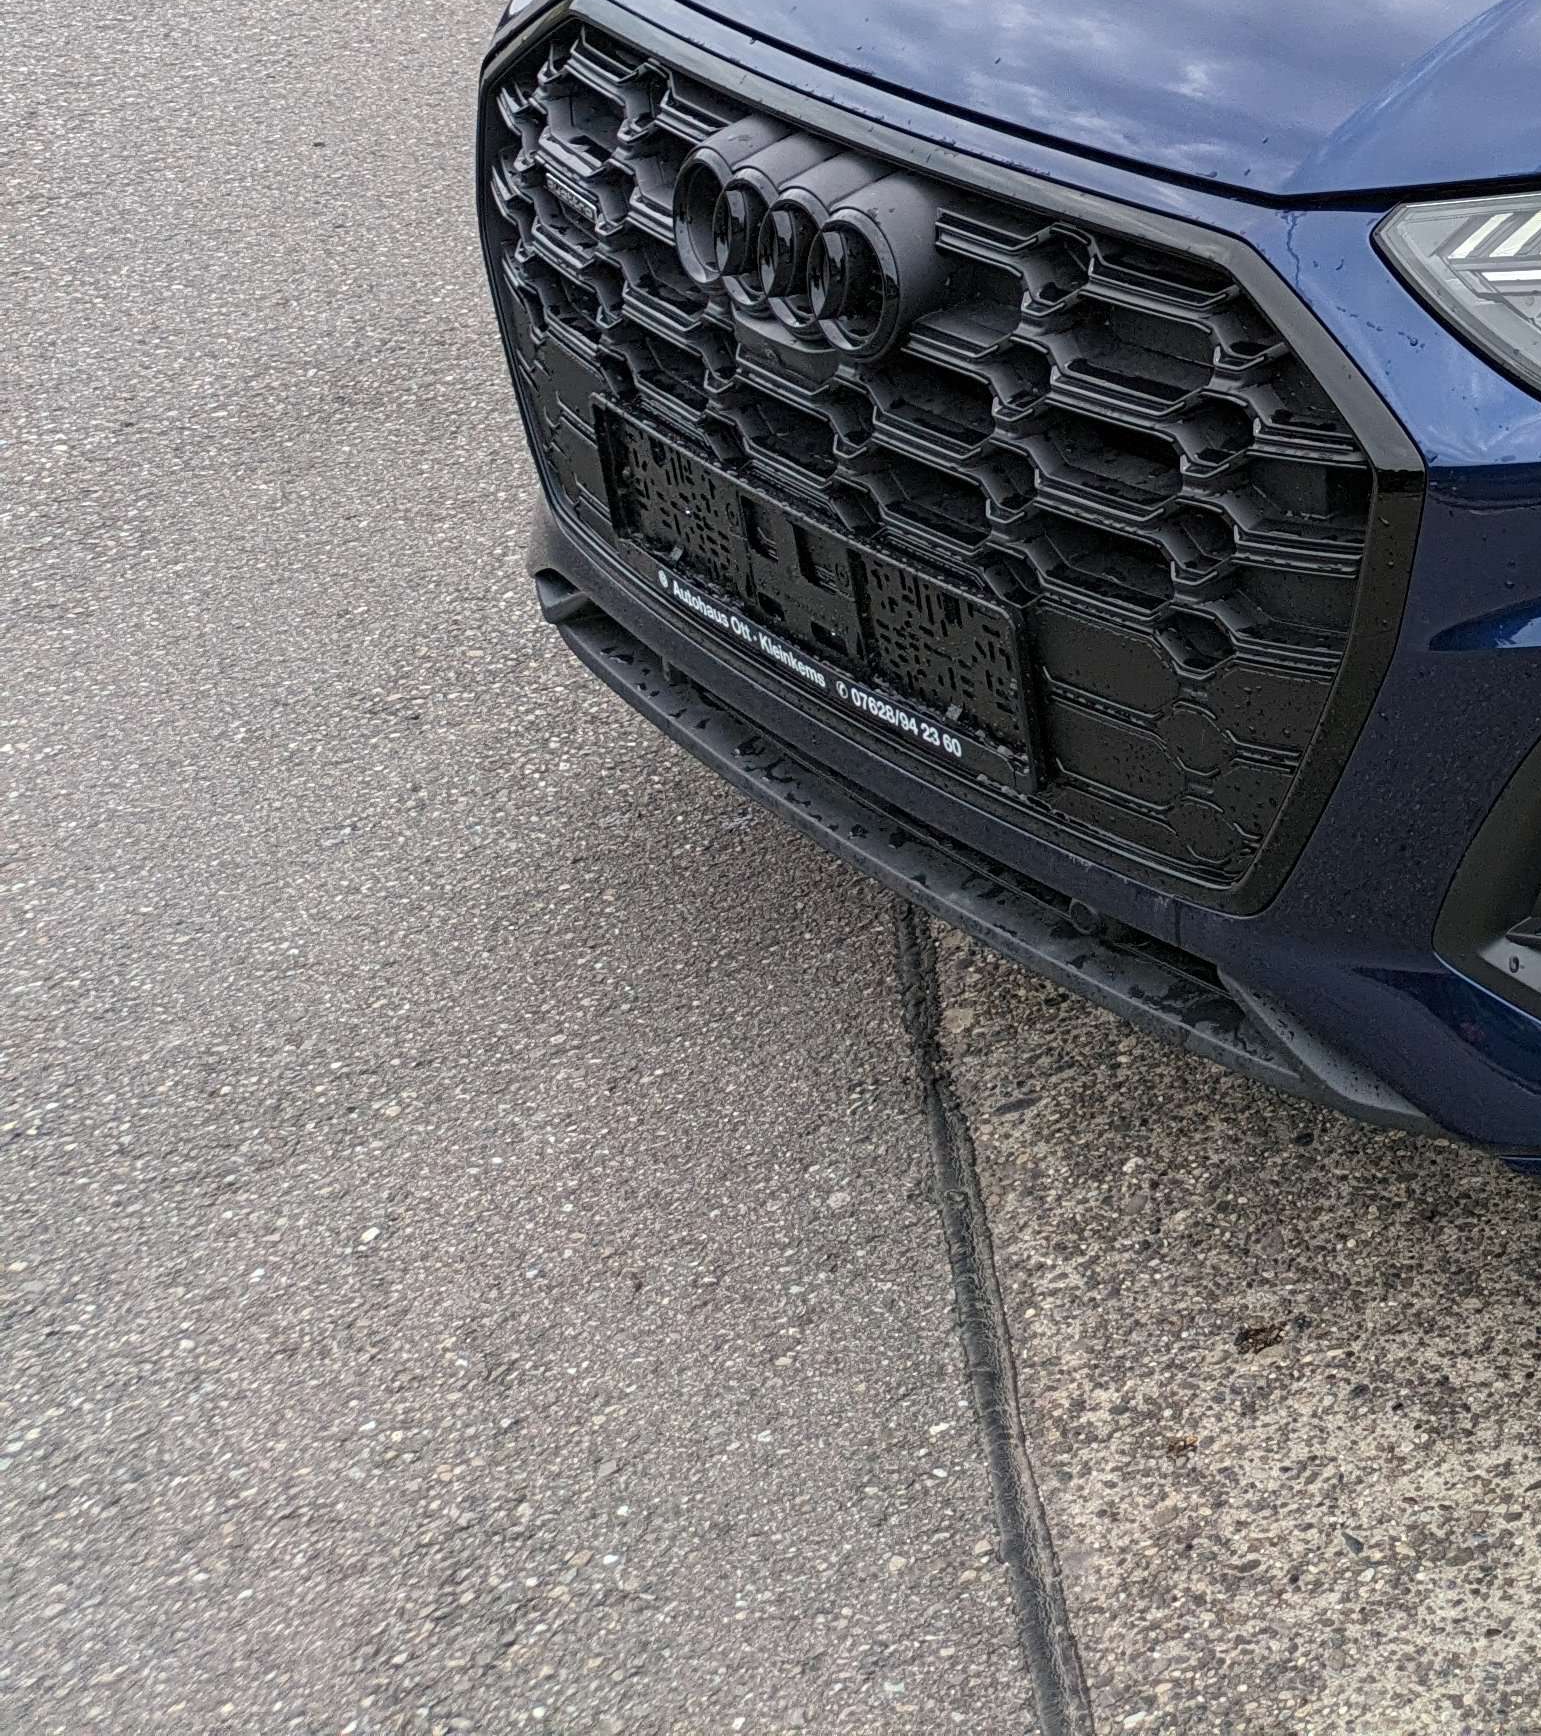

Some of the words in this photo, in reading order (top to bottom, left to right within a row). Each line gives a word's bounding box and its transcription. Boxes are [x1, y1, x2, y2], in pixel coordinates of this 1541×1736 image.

[672, 580, 729, 628] Autohaus
[730, 616, 753, 642] Ott
[759, 632, 826, 688] Kleinkems
[851, 687, 918, 736] 07628/94
[921, 723, 941, 746] 23
[942, 733, 962, 758] 60
